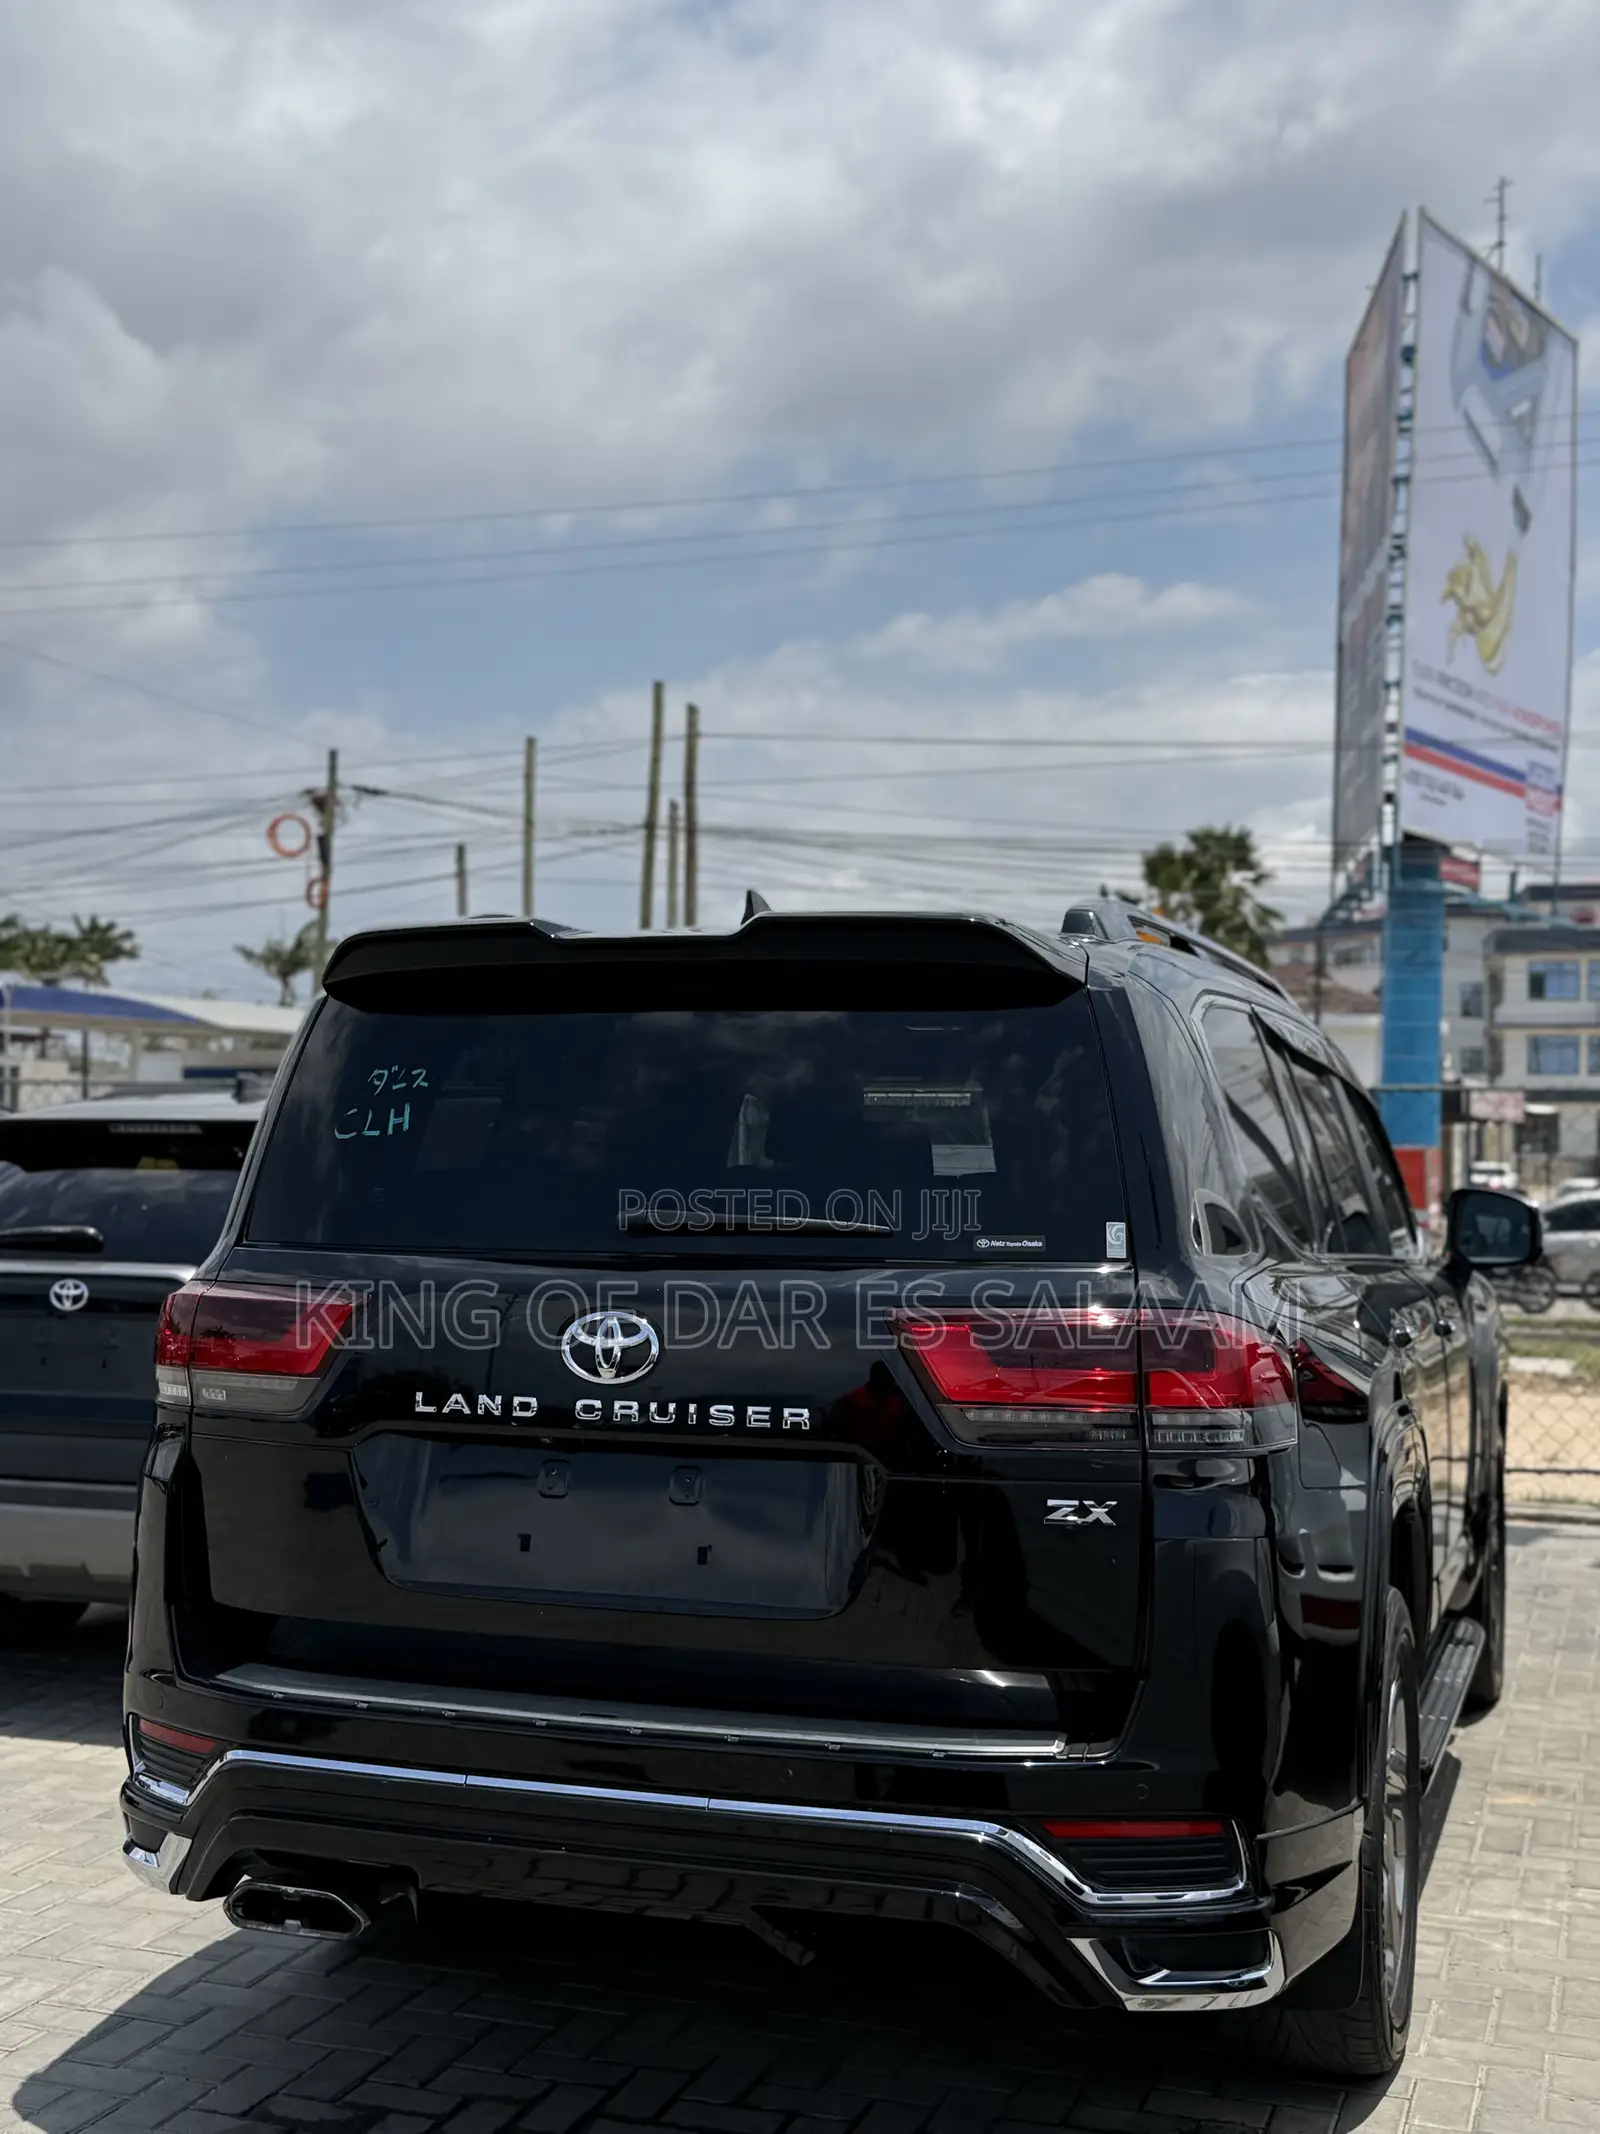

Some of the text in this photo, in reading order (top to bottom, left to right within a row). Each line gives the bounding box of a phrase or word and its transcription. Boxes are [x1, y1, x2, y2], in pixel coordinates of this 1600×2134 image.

[334, 1102, 411, 1139] CLH
[414, 1391, 811, 1431] LAND CRUISER
[1043, 1498, 1118, 1526] ZX
